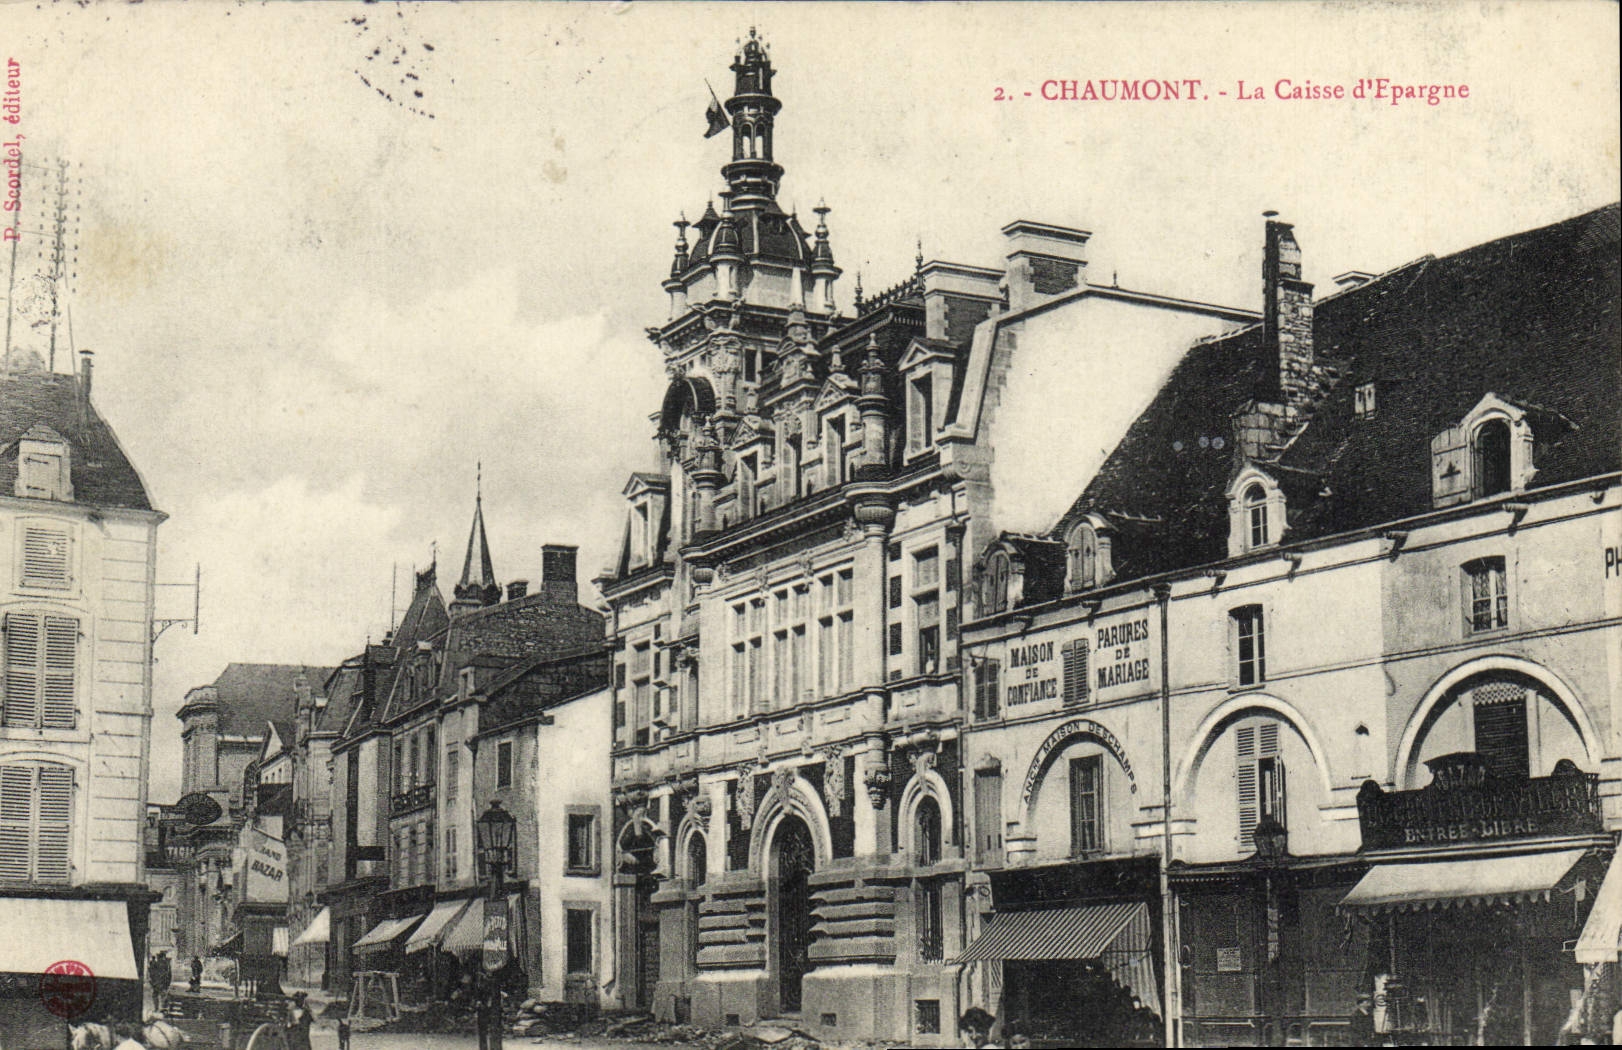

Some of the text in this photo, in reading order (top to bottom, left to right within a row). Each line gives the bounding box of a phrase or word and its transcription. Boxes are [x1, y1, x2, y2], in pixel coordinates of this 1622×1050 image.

[1097, 619, 1149, 649] PARURES
[1010, 641, 1054, 668] MAISON
[1115, 647, 1130, 660] DE
[1025, 667, 1038, 680] DE
[1097, 658, 1149, 689] MARIAGE
[1007, 678, 1057, 707] CONFIANCE
[1043, 721, 1080, 754] MAISON
[1088, 721, 1138, 795] DESCHAMPS
[251, 859, 283, 881] BAZAR
